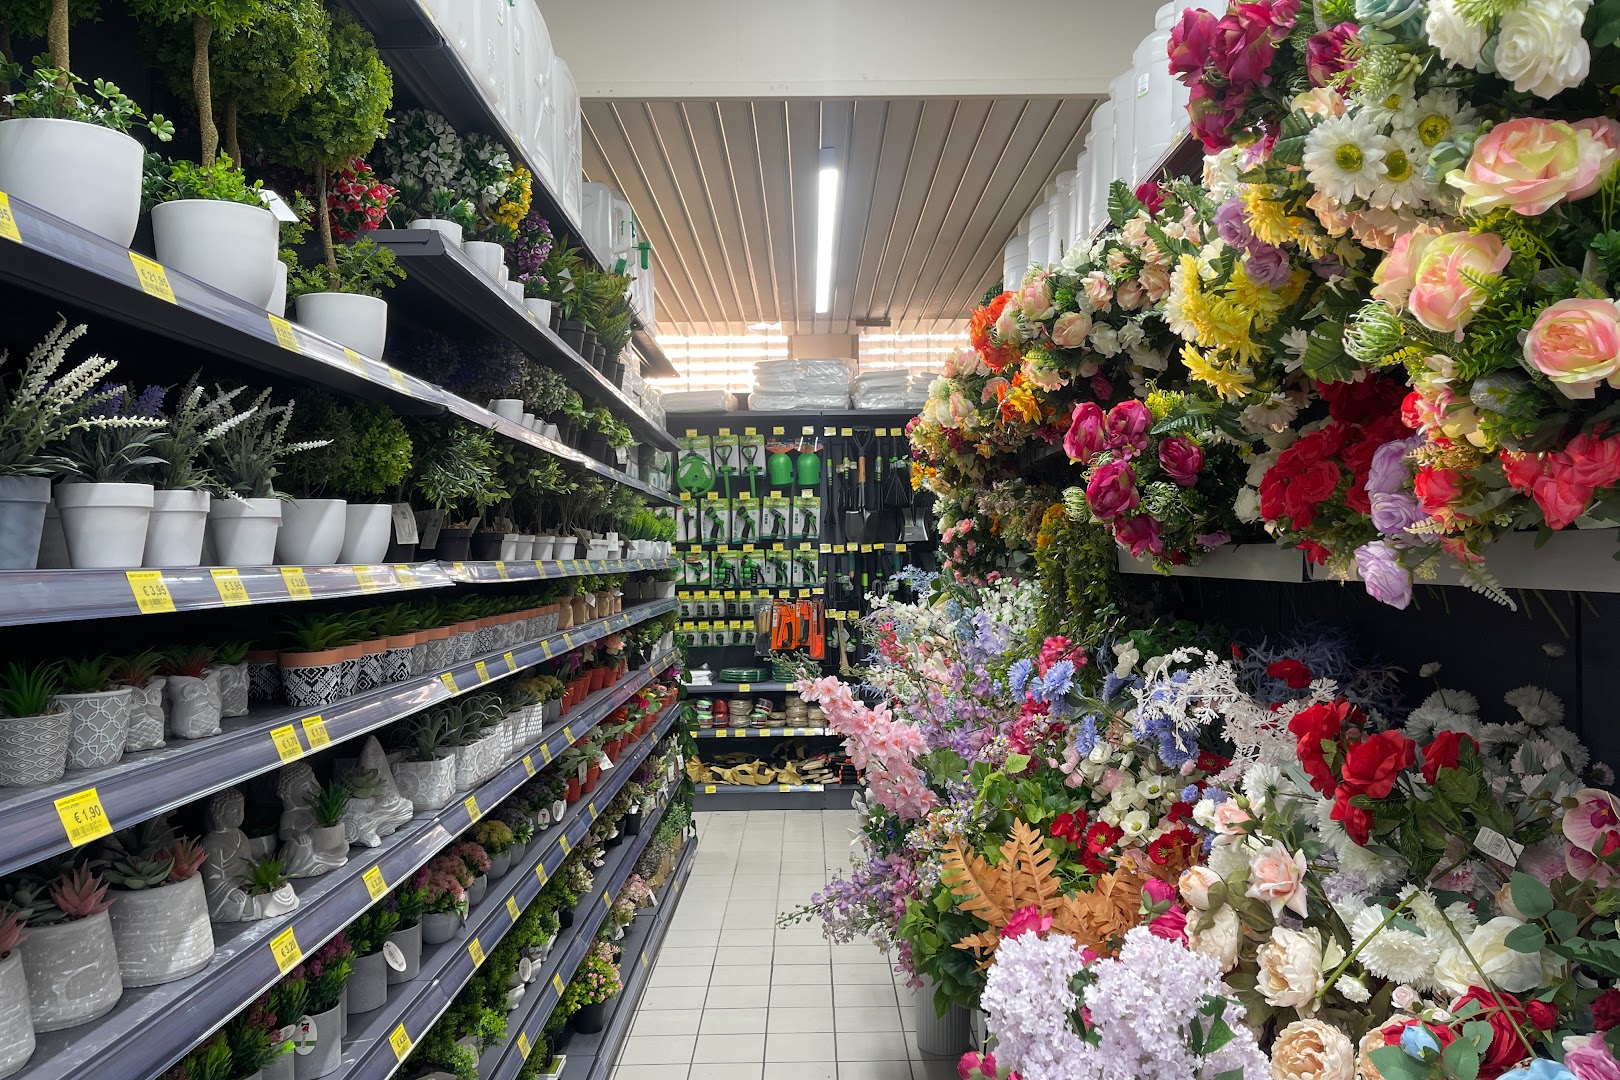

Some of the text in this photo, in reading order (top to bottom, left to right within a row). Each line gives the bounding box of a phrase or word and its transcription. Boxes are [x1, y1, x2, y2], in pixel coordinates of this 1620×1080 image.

[142, 585, 167, 597] € 3,95
[224, 581, 243, 592] € 3,95
[74, 811, 82, 824] €
[81, 804, 102, 822] 1,90
[280, 940, 297, 958] € 3,20
